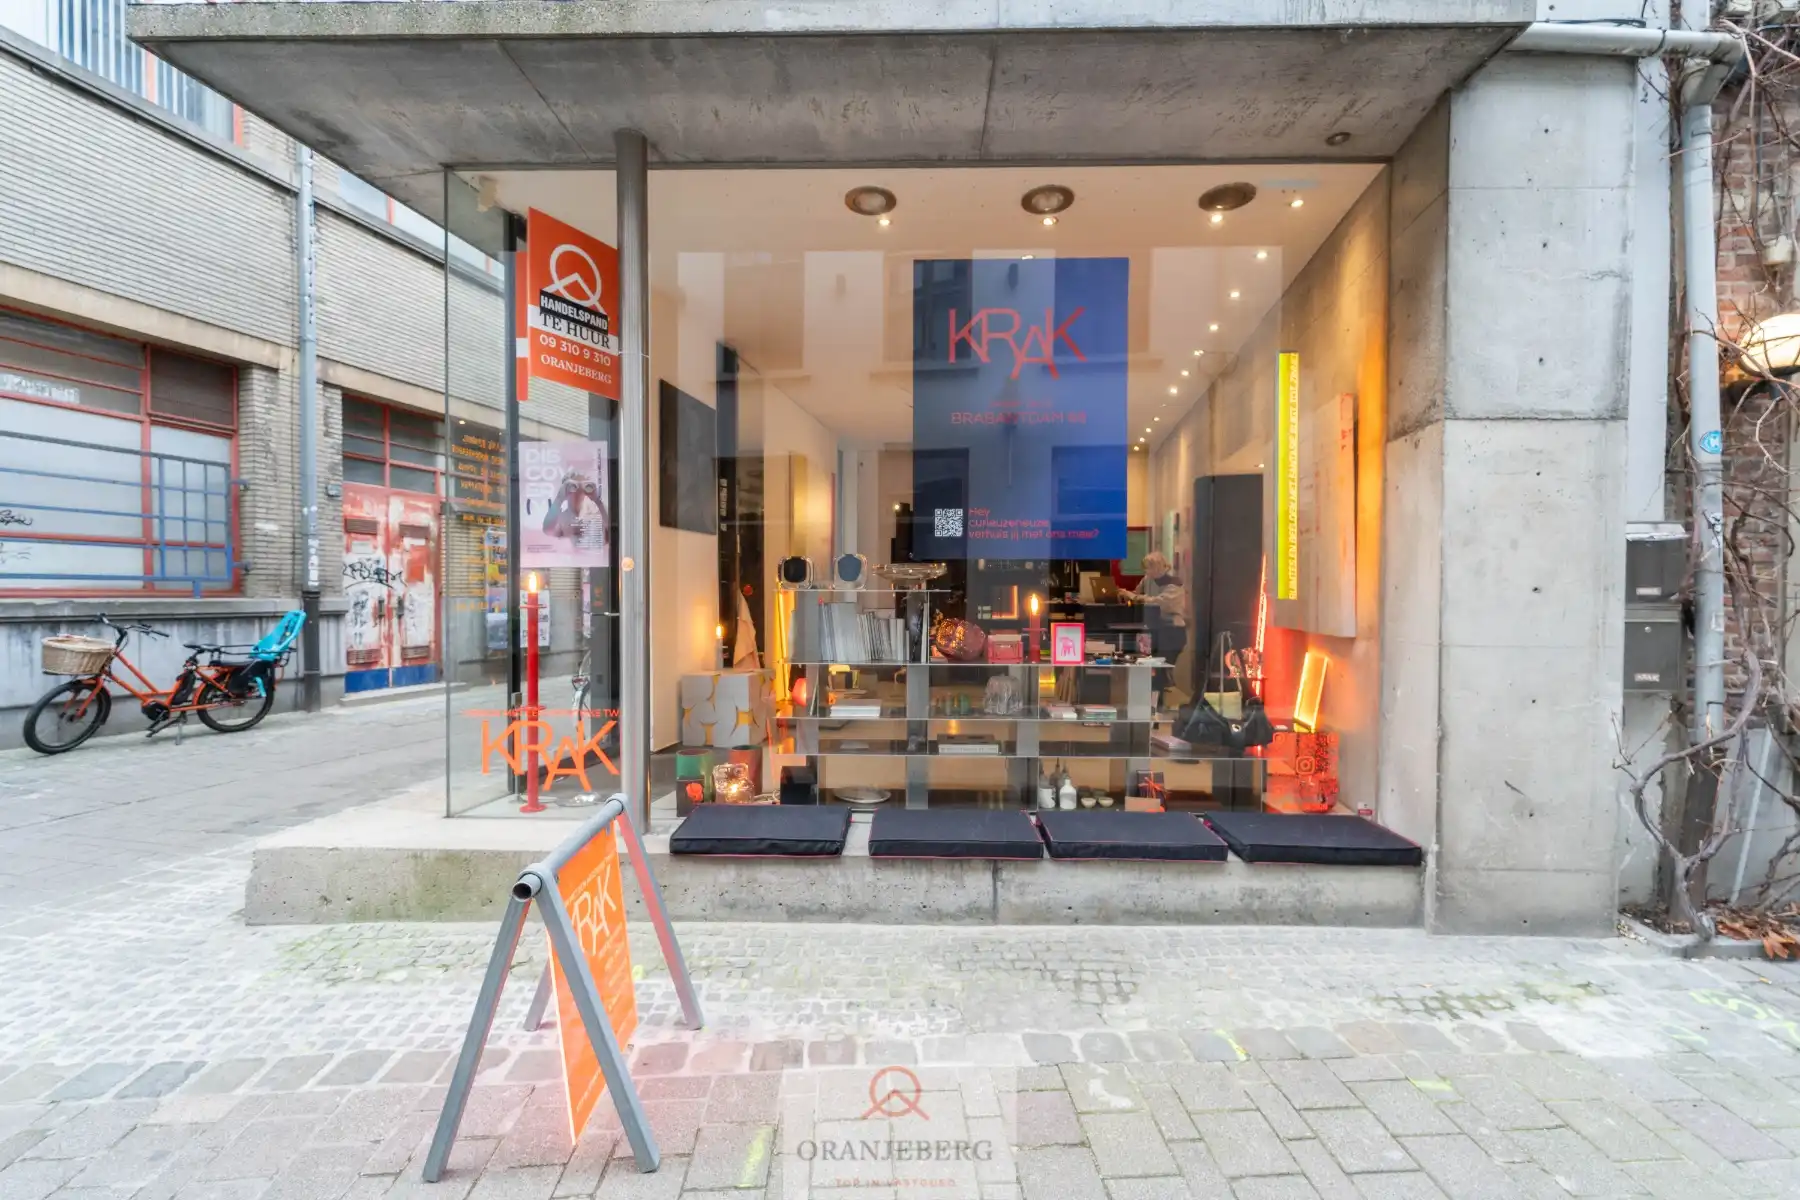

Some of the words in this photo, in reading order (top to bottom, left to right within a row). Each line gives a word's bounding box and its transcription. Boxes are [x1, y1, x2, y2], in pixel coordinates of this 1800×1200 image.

[540, 295, 608, 331] HANDELSPAND
[540, 313, 562, 332] TE
[566, 320, 611, 350] HUUR
[948, 307, 1087, 380] KRAK
[539, 334, 557, 348] 09
[559, 340, 580, 357] 310
[582, 348, 591, 359] 9
[592, 352, 611, 367] 310
[540, 354, 612, 385] ORANJEBERG
[968, 507, 990, 517] Hey
[481, 720, 620, 792] KRAK
